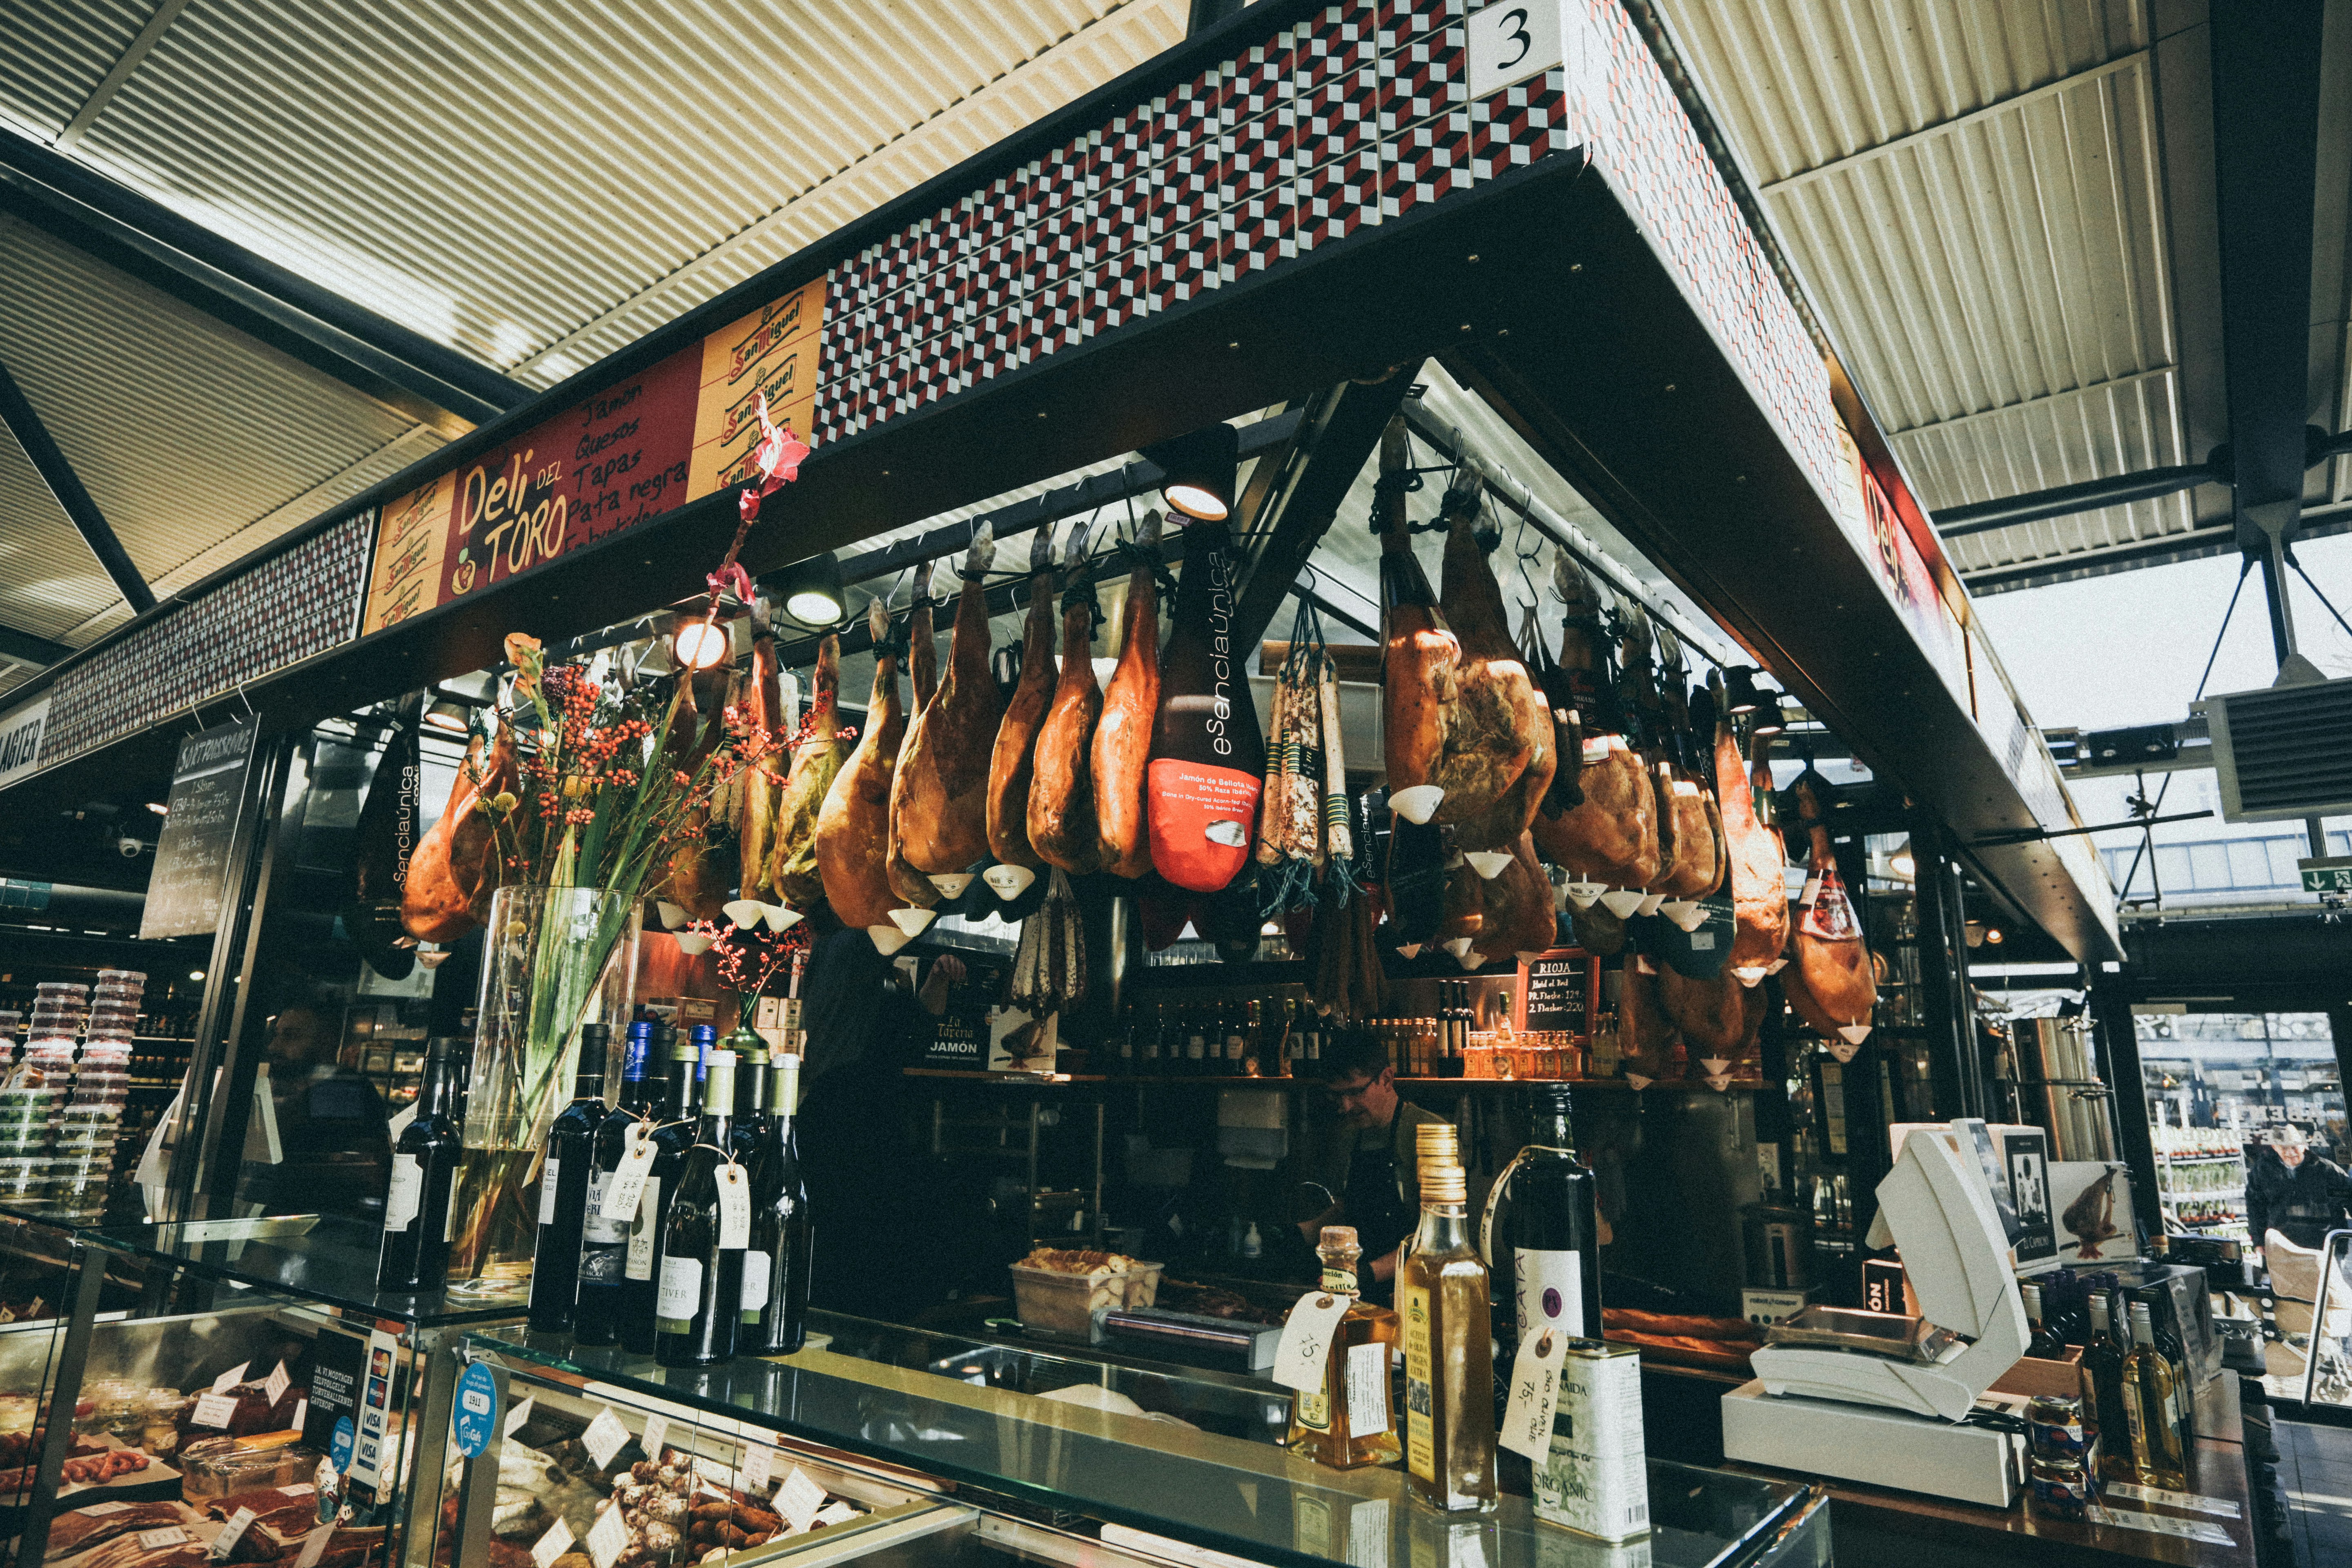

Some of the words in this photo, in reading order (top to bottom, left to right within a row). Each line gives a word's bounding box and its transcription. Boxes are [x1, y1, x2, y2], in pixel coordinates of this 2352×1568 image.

[1497, 8, 1531, 70] 3
[576, 418, 640, 460] Quesos
[573, 449, 642, 492] Tapas
[459, 449, 534, 535] Deli
[537, 460, 563, 490] DEL
[566, 490, 620, 530] Pata
[630, 461, 687, 501] negra
[485, 495, 567, 583] TORO
[1179, 773, 1205, 783] Jamón
[1218, 778, 1245, 788] Bellota
[1185, 794, 1212, 803] Dry-cured
[1539, 962, 1570, 974] RIOJA
[1528, 1004, 1536, 1013] 2
[930, 1041, 977, 1054] JAMÓN
[328, 1369, 354, 1385] MODTAGER
[311, 1396, 334, 1412] GAVEKORT
[469, 1395, 481, 1407] 1911
[366, 1412, 380, 1429] VISA
[362, 1443, 376, 1459] VISA
[1533, 1472, 1593, 1503] ORGANIC
